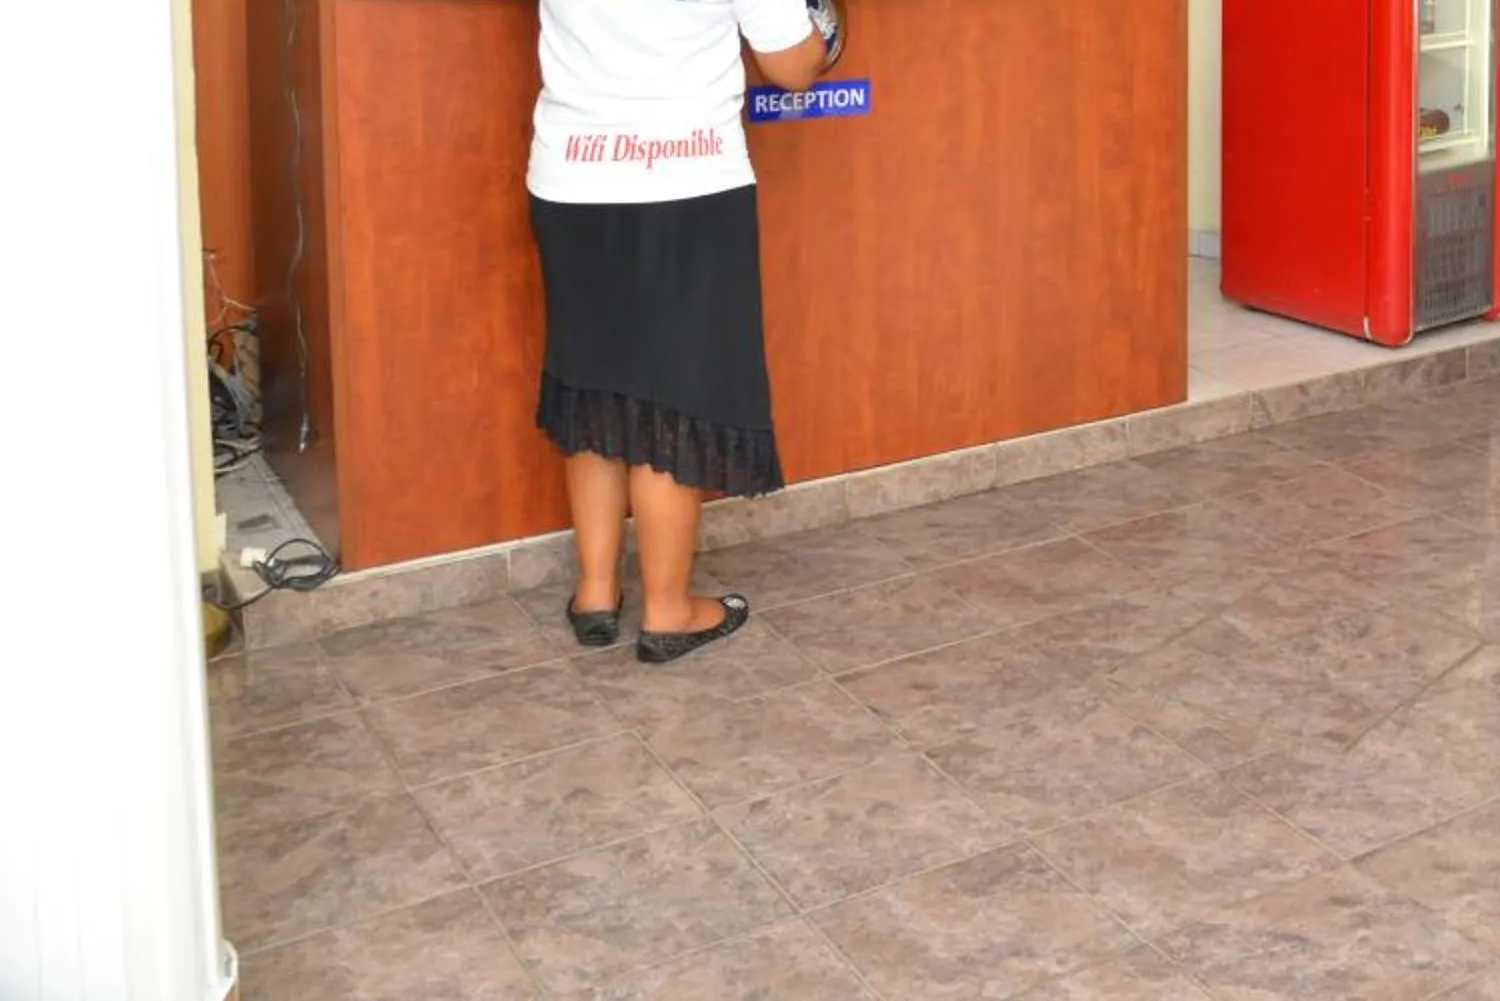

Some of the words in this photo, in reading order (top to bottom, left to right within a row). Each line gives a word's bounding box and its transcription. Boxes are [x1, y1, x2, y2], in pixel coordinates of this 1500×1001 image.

[754, 87, 866, 114] RECEPTION
[564, 133, 608, 163] Wifi
[611, 127, 724, 169] Disponible
